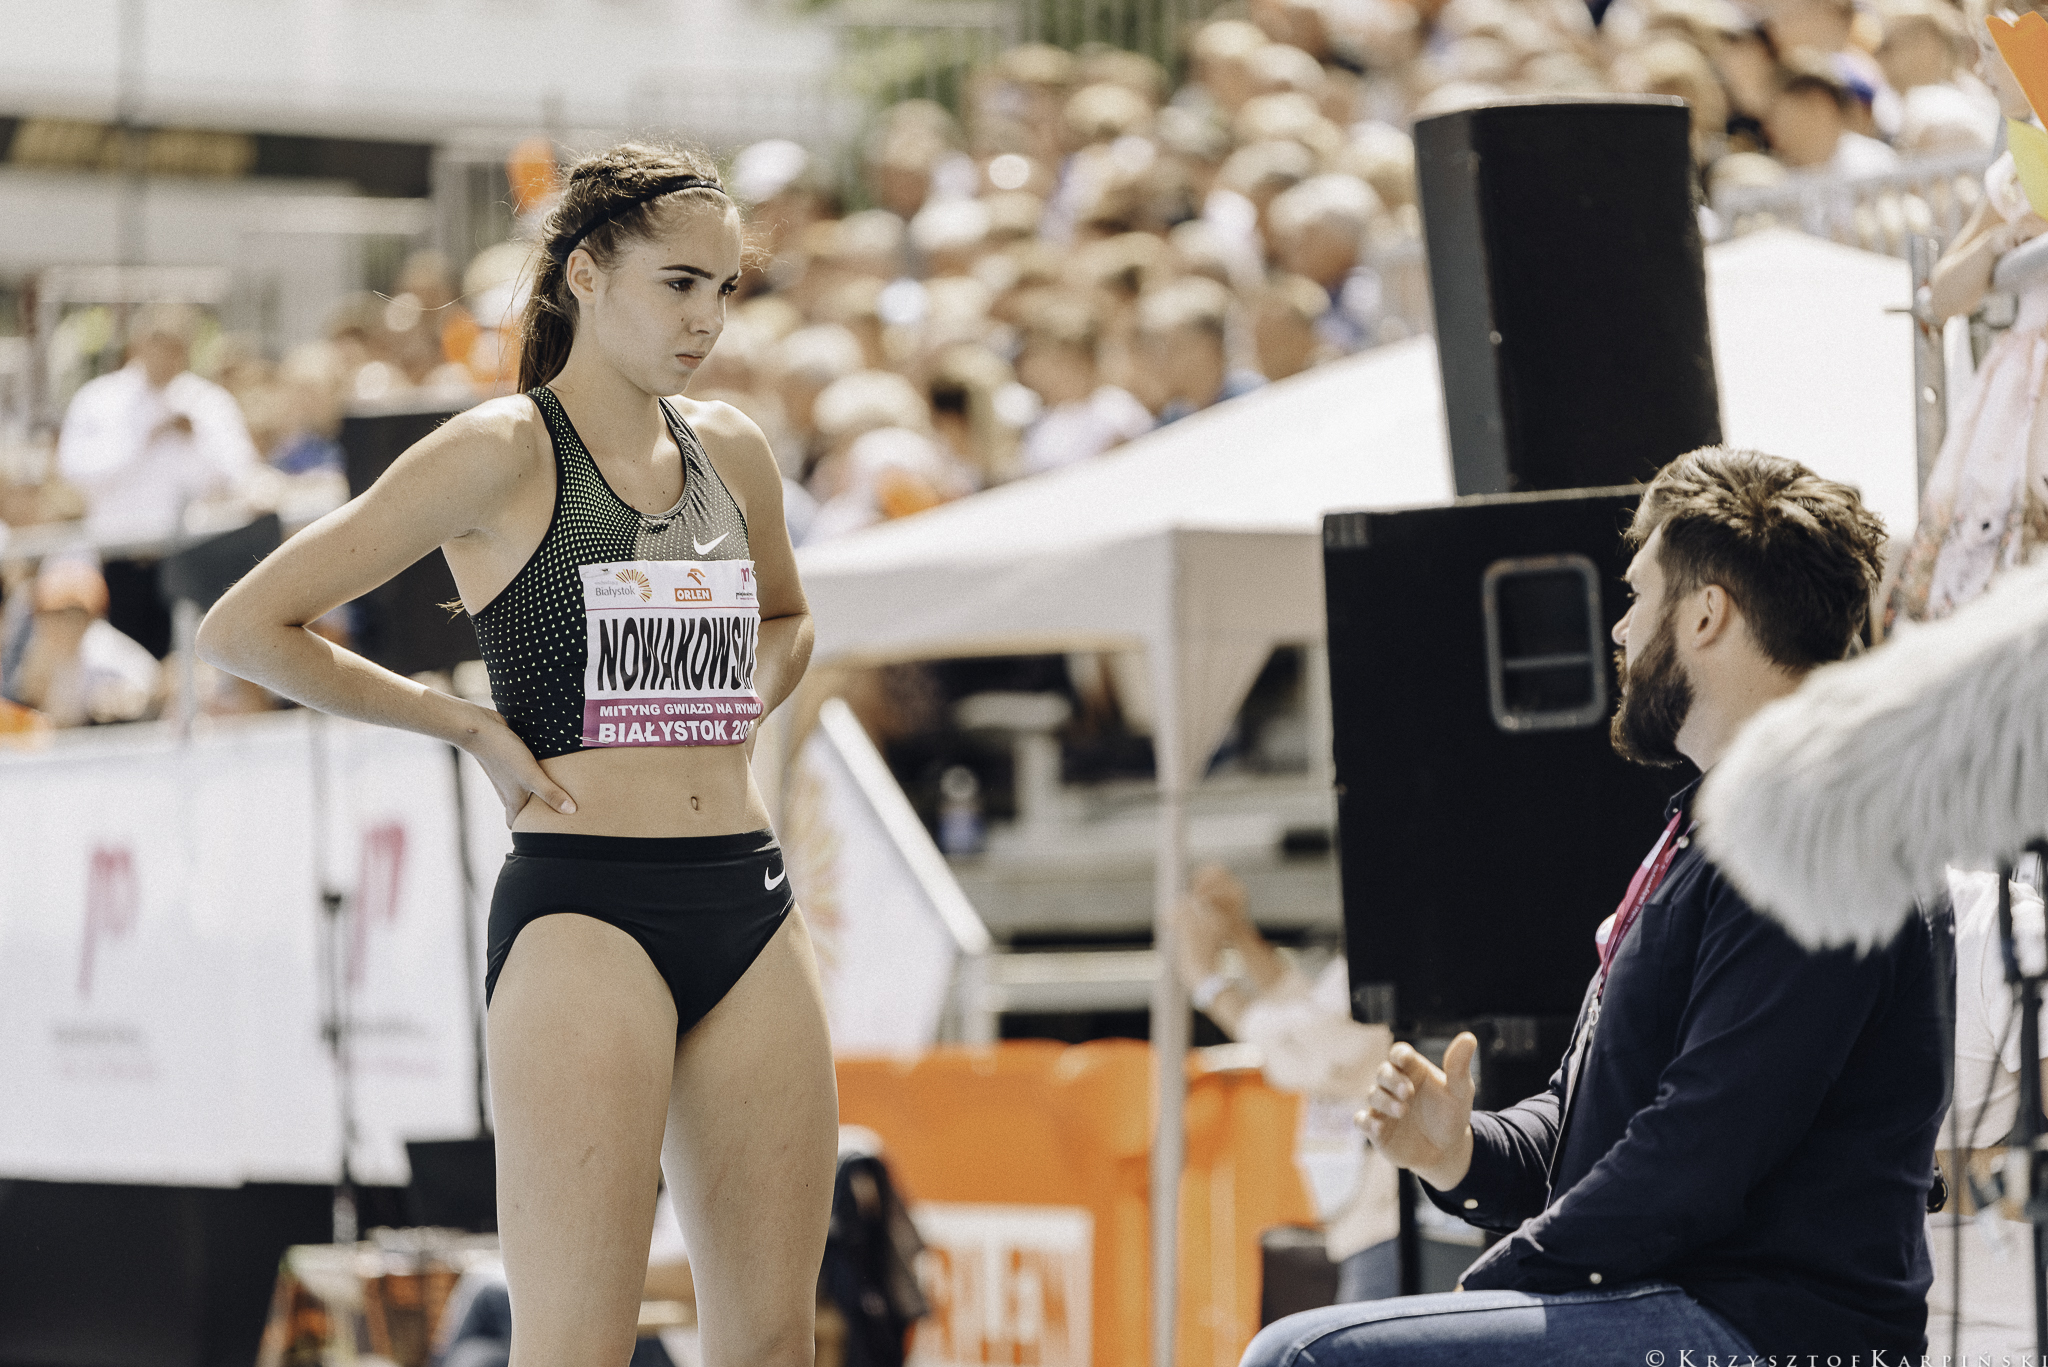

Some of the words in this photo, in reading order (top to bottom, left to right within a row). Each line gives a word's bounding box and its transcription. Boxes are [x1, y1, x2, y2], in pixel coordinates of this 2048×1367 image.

[595, 586, 636, 598] Białystok
[676, 589, 711, 601] ORLEN
[600, 705, 660, 717] MITYNG
[664, 703, 714, 715] GWIAZD
[715, 703, 733, 714] NA
[599, 720, 728, 743] BIAŁYSTOK
[731, 720, 749, 740] 20
